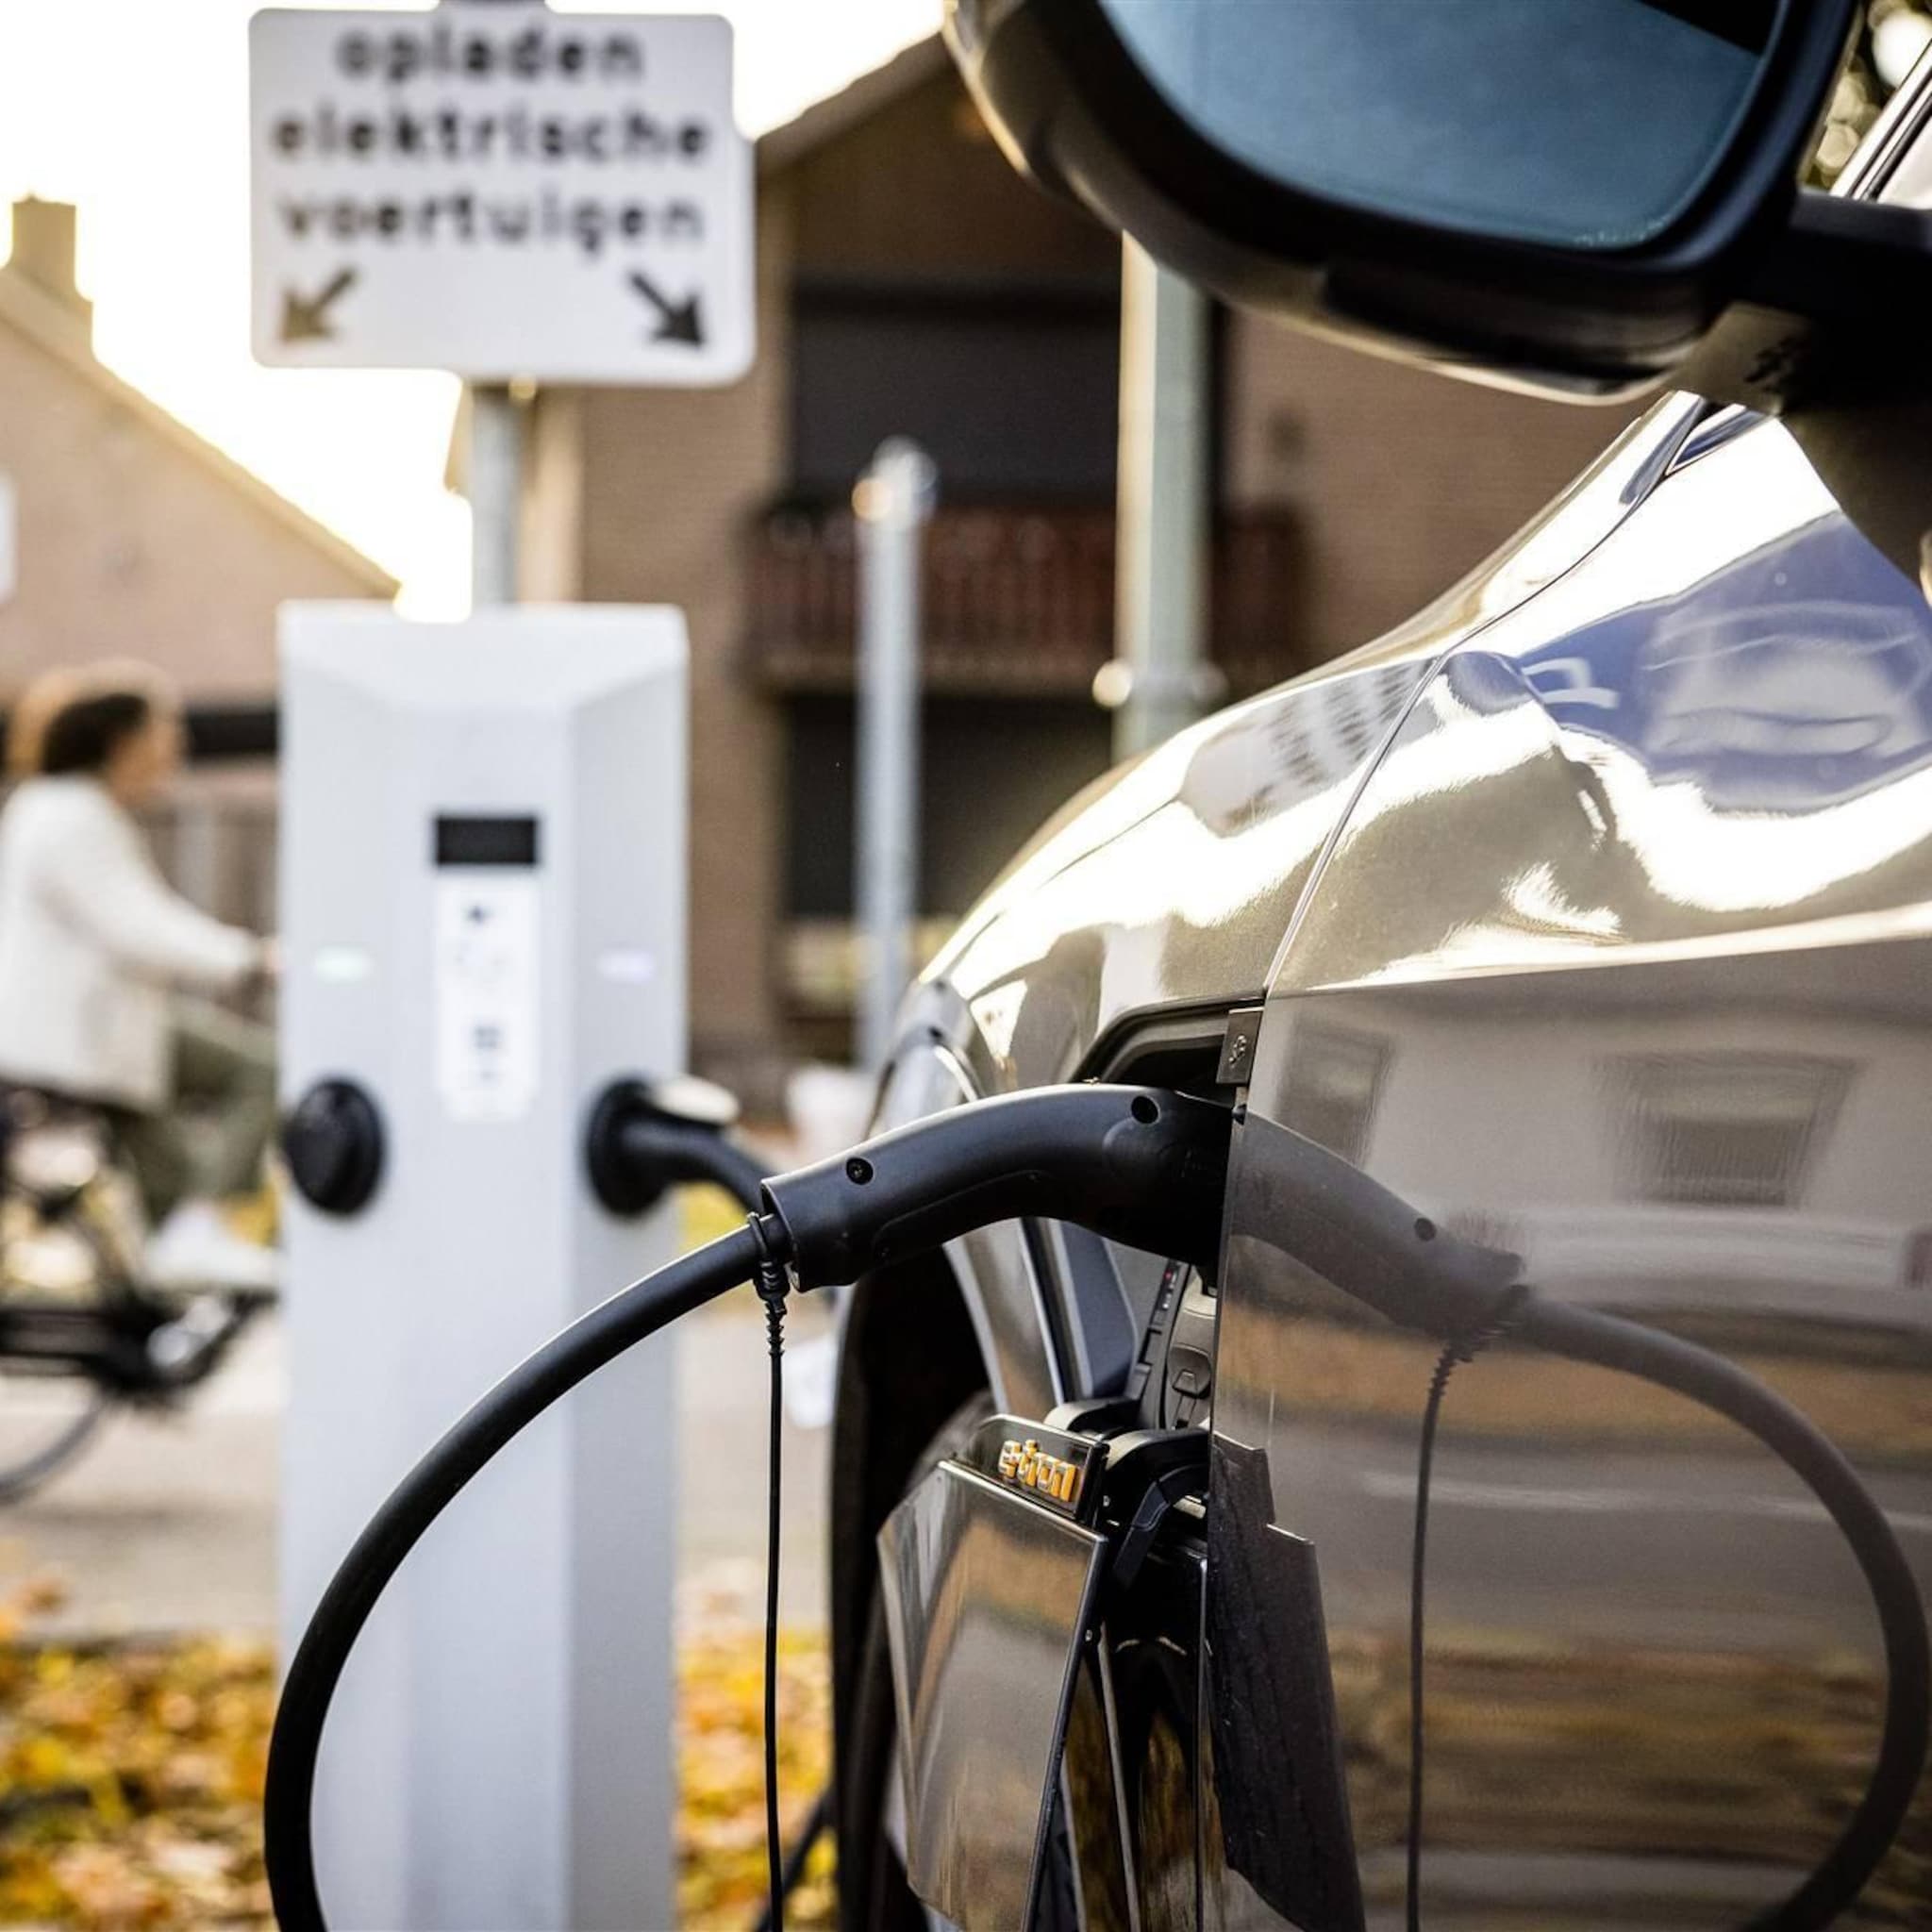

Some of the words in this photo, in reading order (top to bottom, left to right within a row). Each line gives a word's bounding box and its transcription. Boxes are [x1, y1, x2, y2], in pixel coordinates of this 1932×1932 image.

[337, 22, 643, 83] opladen
[274, 105, 709, 161] elektrische
[280, 192, 704, 259] voertuigen
